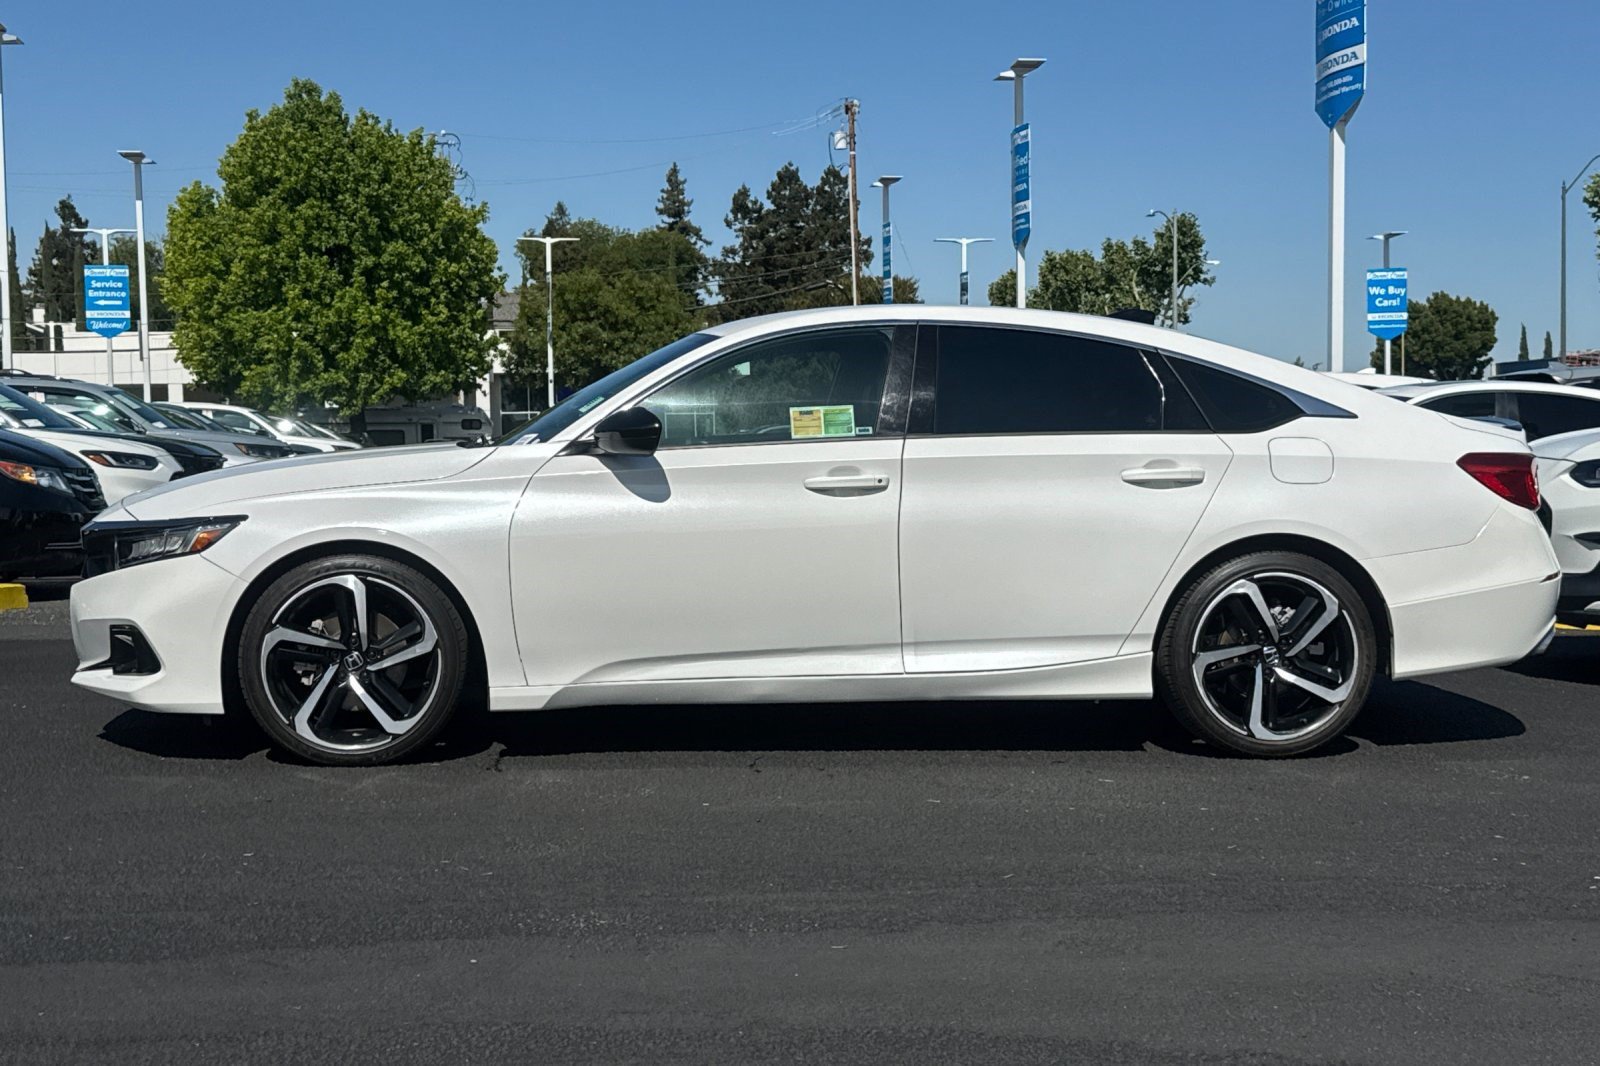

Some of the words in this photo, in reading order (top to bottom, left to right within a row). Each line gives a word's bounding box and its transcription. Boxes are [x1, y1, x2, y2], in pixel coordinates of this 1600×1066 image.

[91, 280, 123, 288] Service
[1369, 286, 1386, 295] We
[1388, 285, 1406, 297] Buy
[1375, 297, 1400, 307] Cars!
[90, 320, 127, 330] Welcome!
